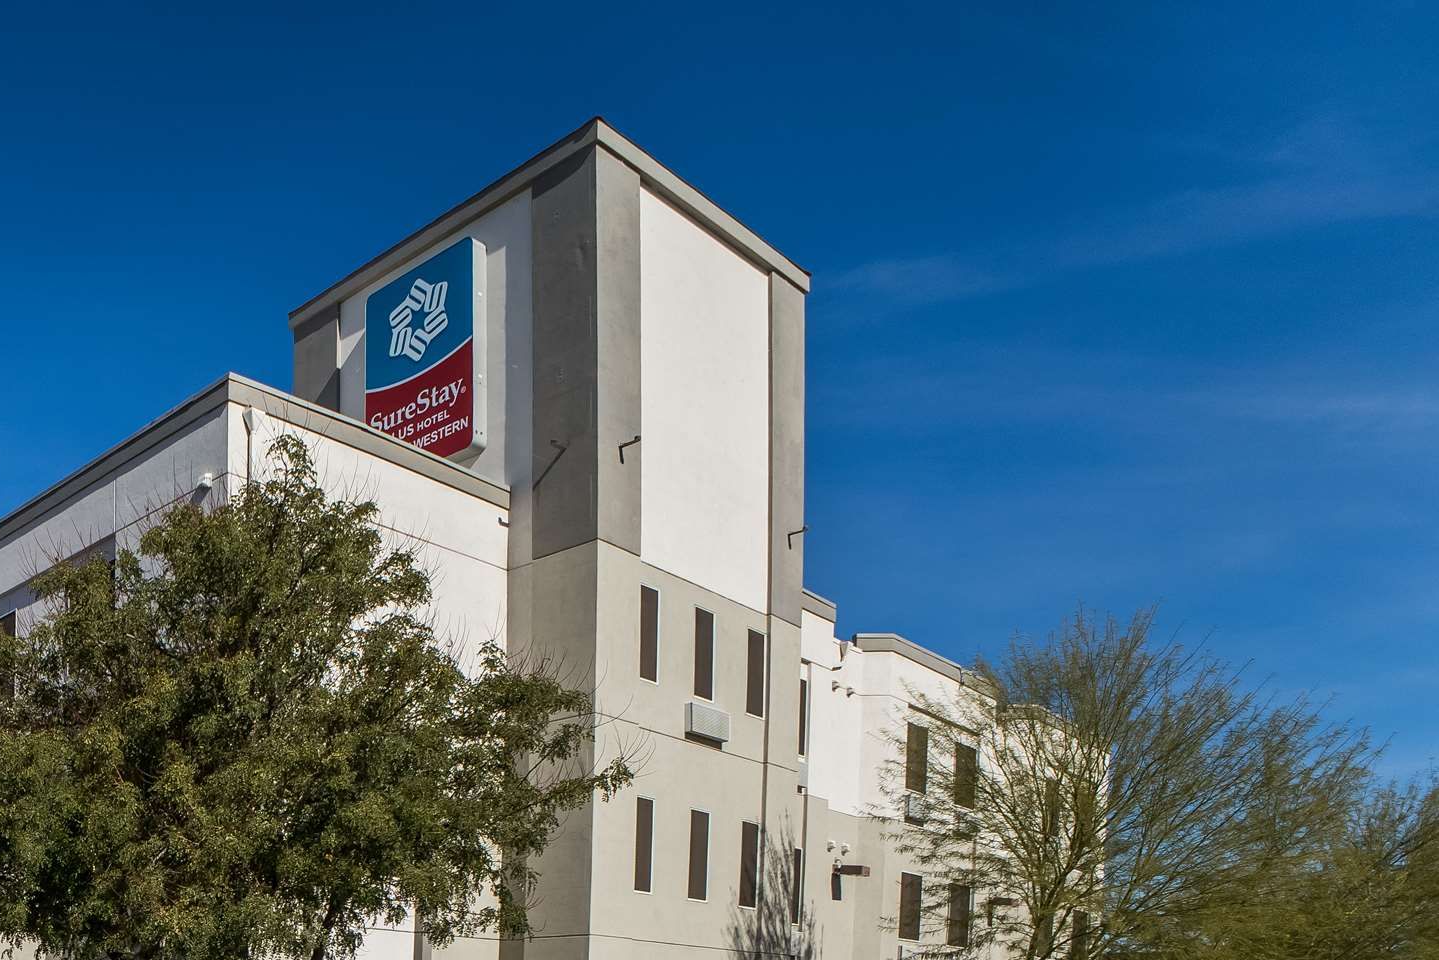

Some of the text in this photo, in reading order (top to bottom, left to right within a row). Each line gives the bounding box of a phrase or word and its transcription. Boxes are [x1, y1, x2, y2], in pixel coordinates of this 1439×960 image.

[370, 378, 463, 431] SureStay
[416, 409, 450, 432] HOTEL
[413, 416, 469, 449] WESTERN
